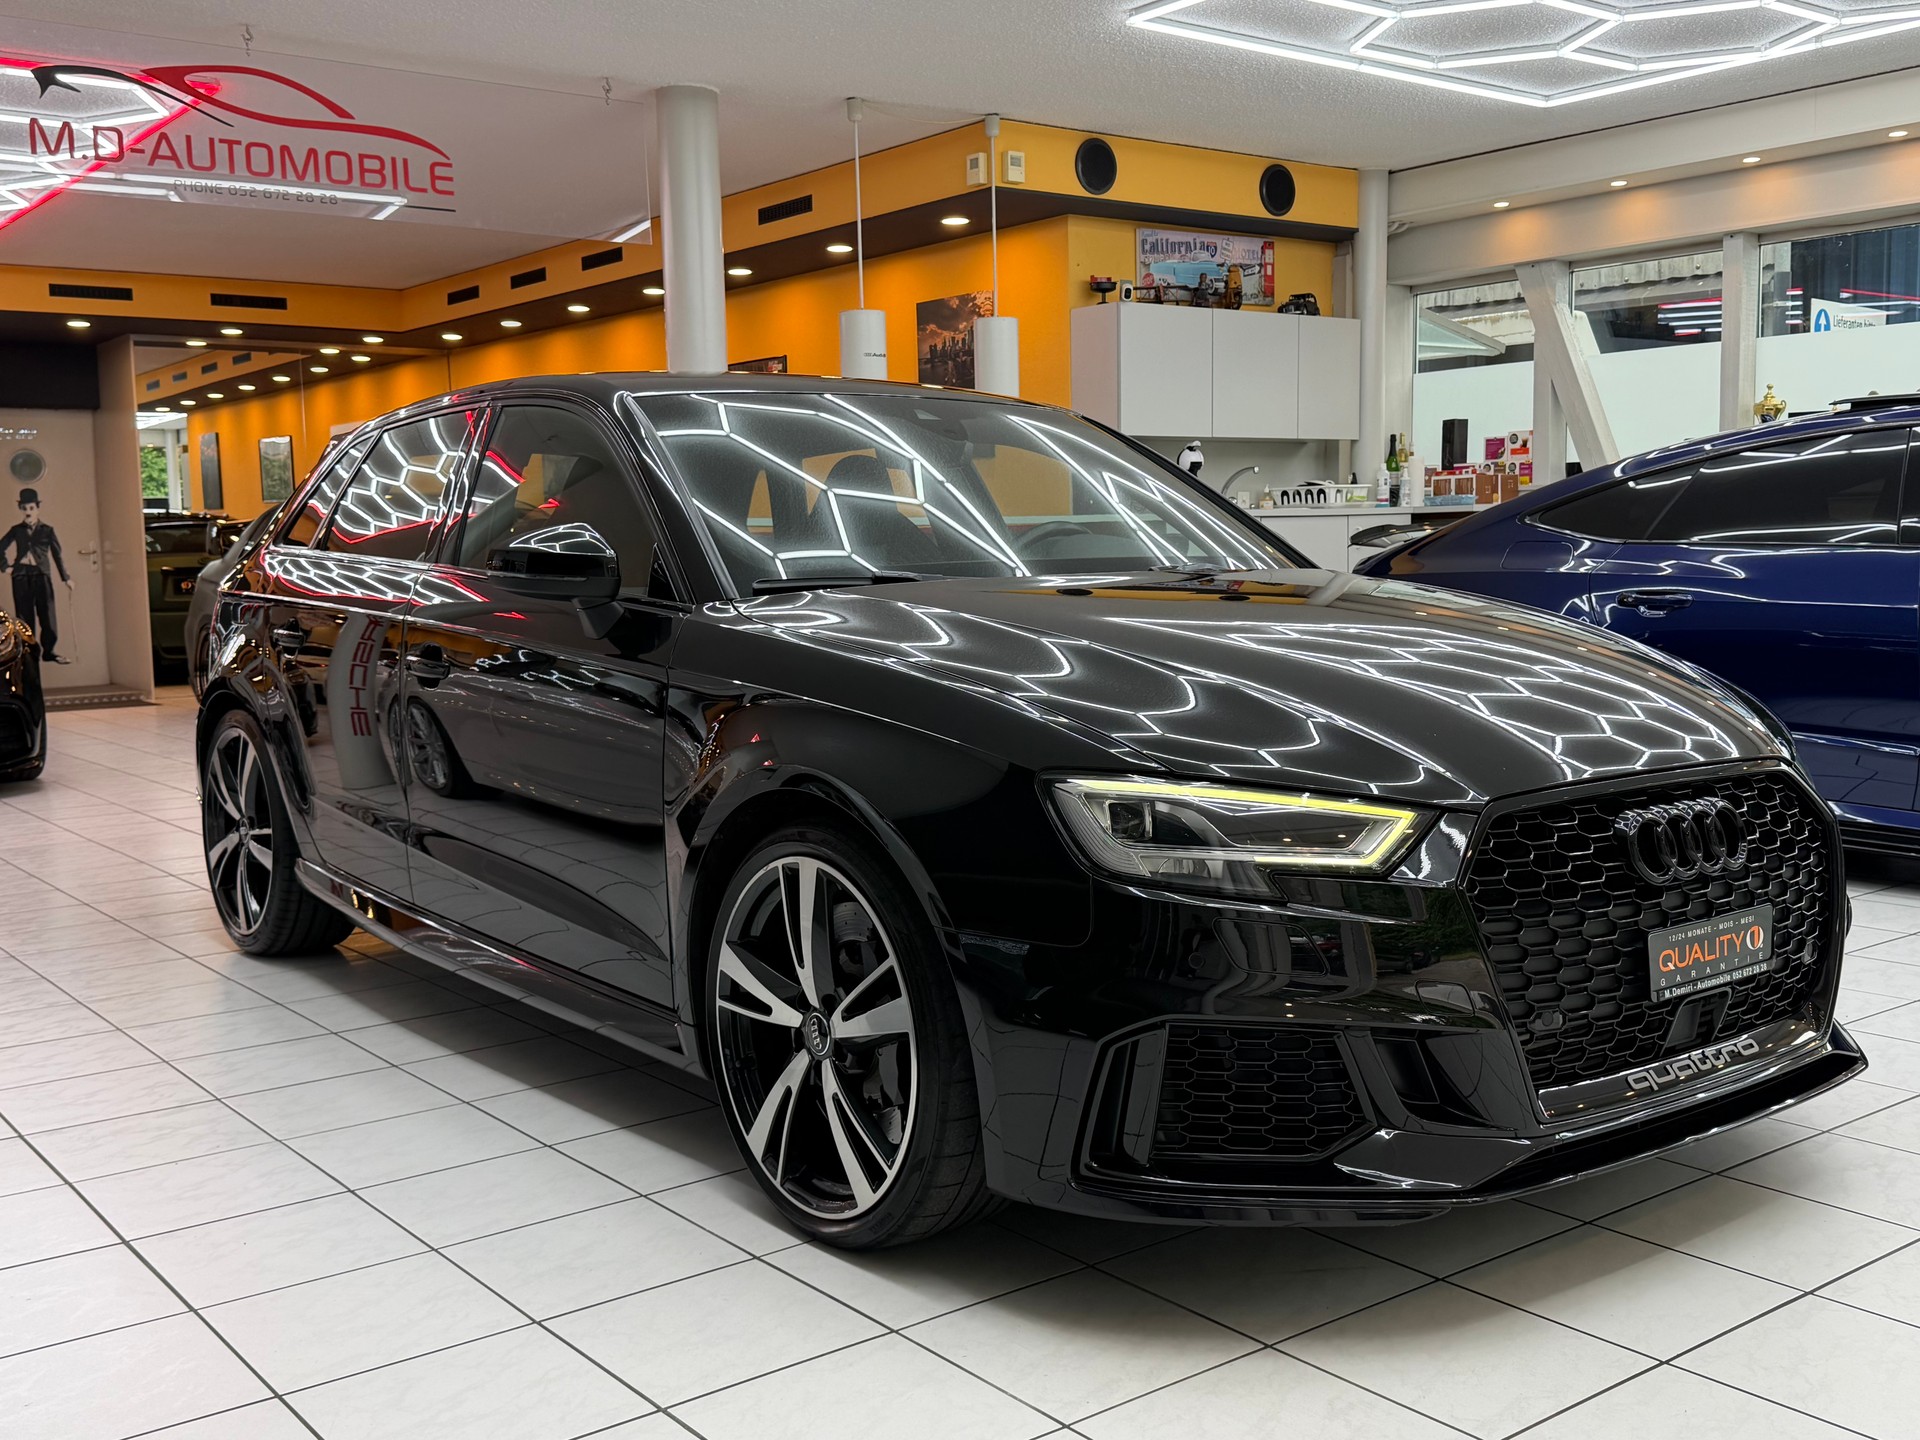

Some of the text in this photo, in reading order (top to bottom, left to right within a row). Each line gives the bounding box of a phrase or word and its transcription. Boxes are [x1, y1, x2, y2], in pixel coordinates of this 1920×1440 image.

[29, 117, 455, 196] M.D-AUTOMOBILE
[173, 179, 338, 205] PHONE 052 672 28 28
[1141, 238, 1206, 256] California
[1668, 931, 1685, 943] 12/24
[1687, 926, 1712, 938] MONATE
[1718, 921, 1734, 930] MOIS
[1740, 915, 1755, 925] MESI
[1659, 930, 1744, 972] QUALITY
[1660, 951, 1763, 986] GARANTIE
[1732, 970, 1742, 979] 052
[1743, 967, 1753, 976] 672
[1753, 965, 1760, 974] 28
[1760, 962, 1768, 971] 28
[1627, 1038, 1760, 1092] quattro
